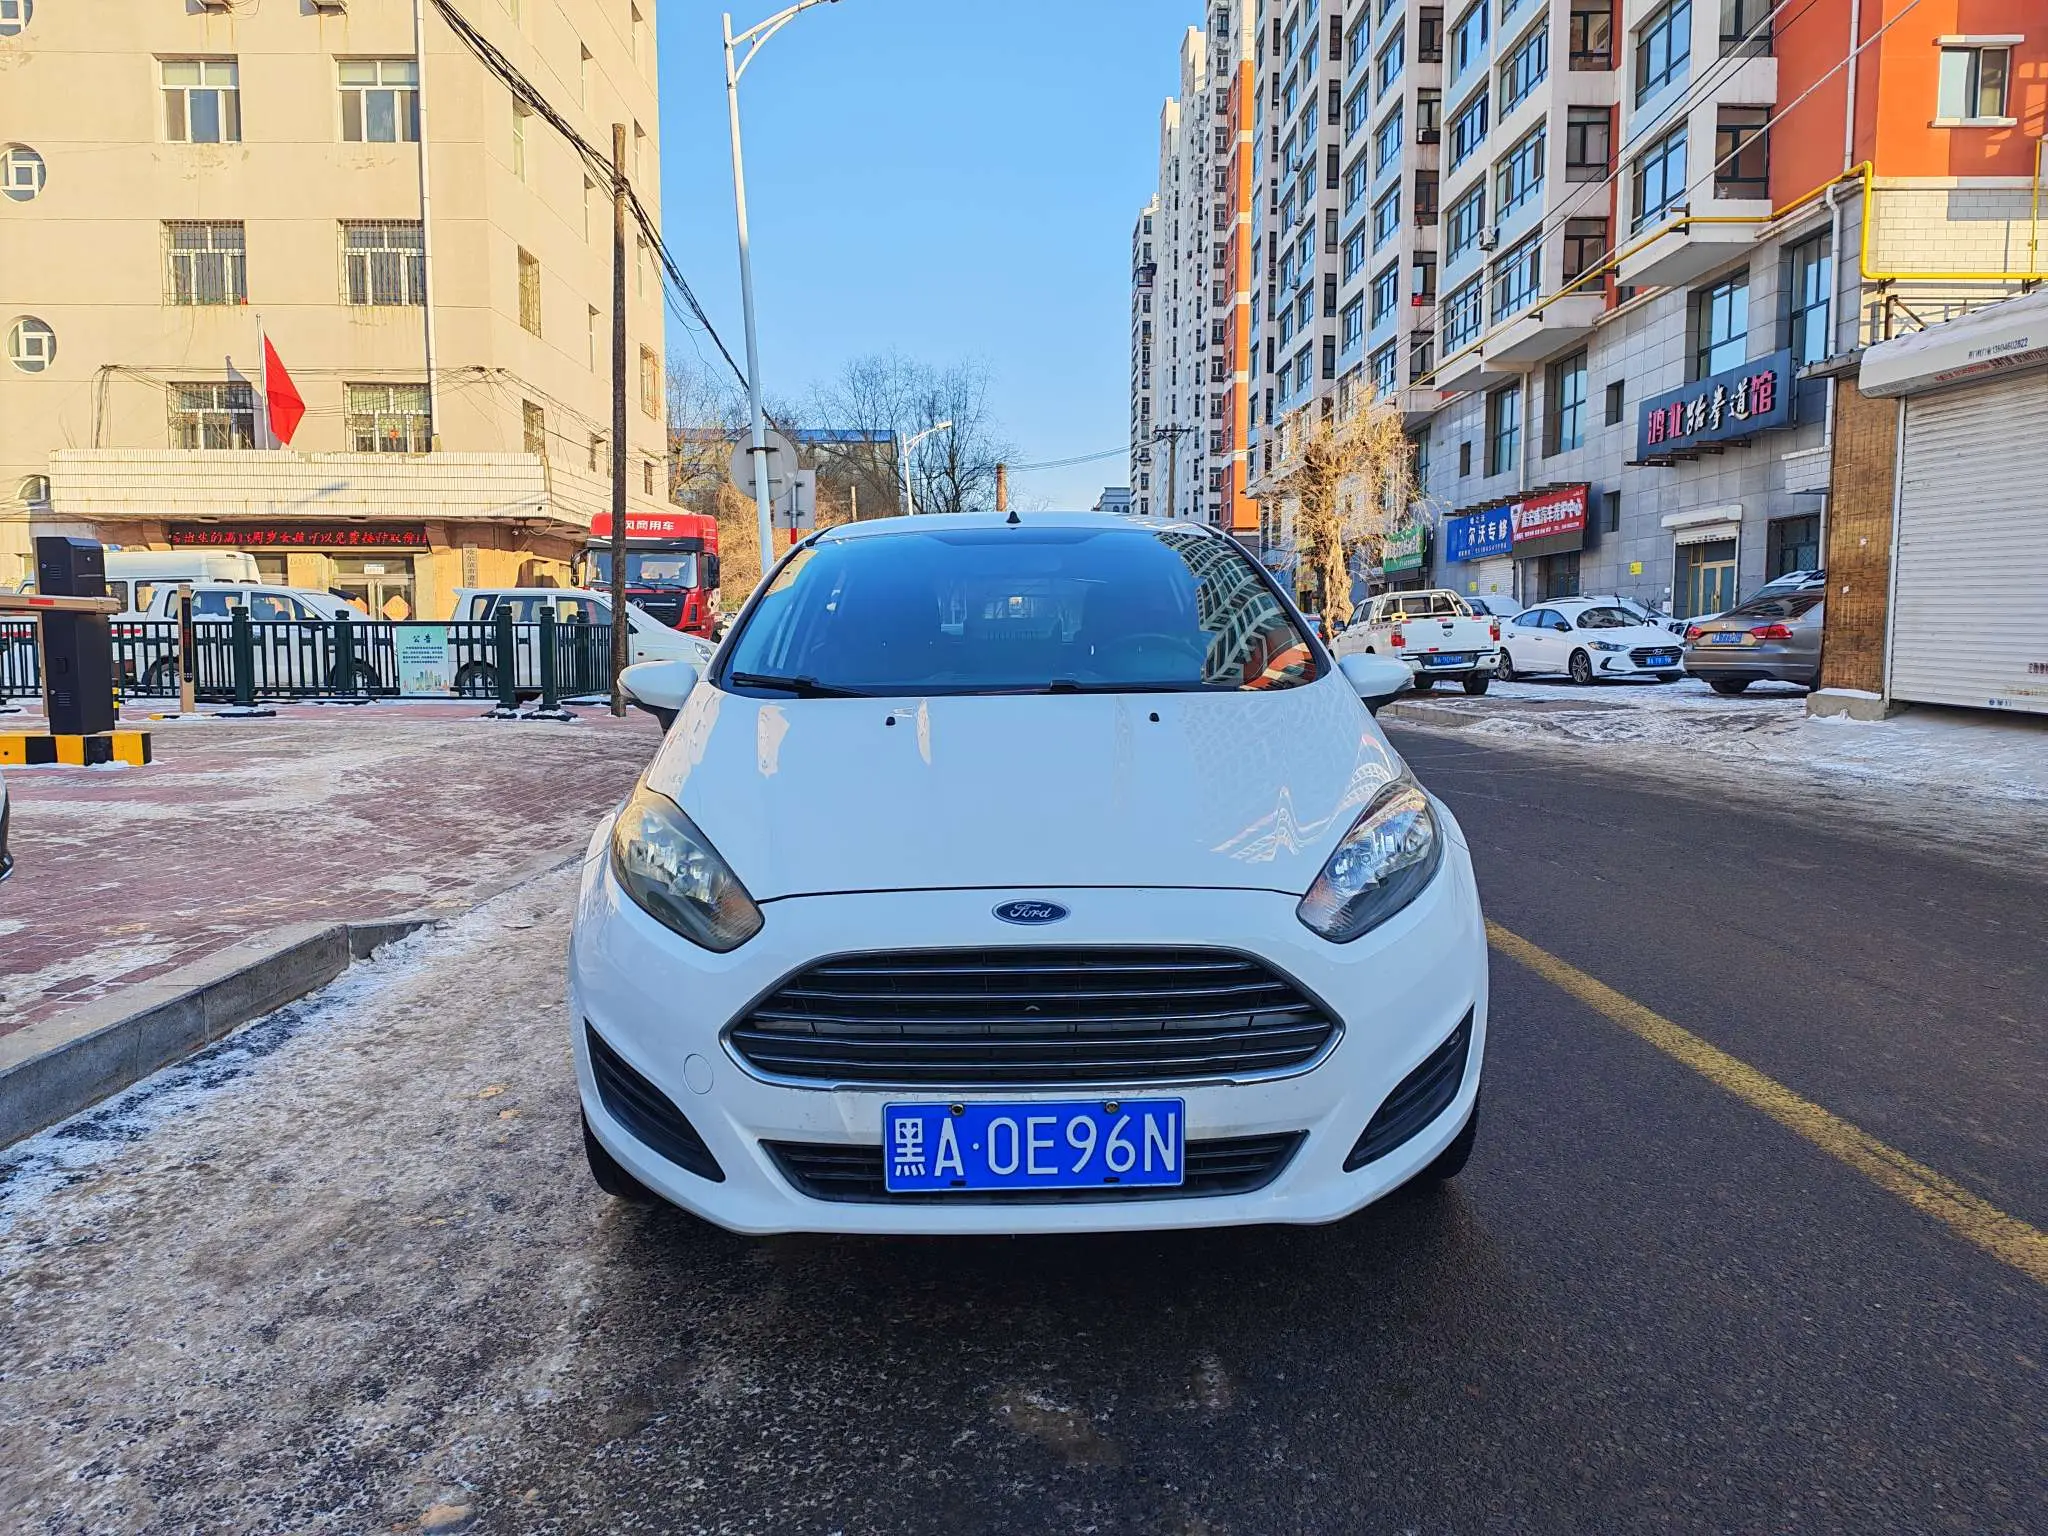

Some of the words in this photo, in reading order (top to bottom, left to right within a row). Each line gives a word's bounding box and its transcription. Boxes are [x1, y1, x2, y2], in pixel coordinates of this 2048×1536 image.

[1648, 370, 1774, 445] 鸿北跆拳道馆
[1010, 904, 1052, 918] Ford
